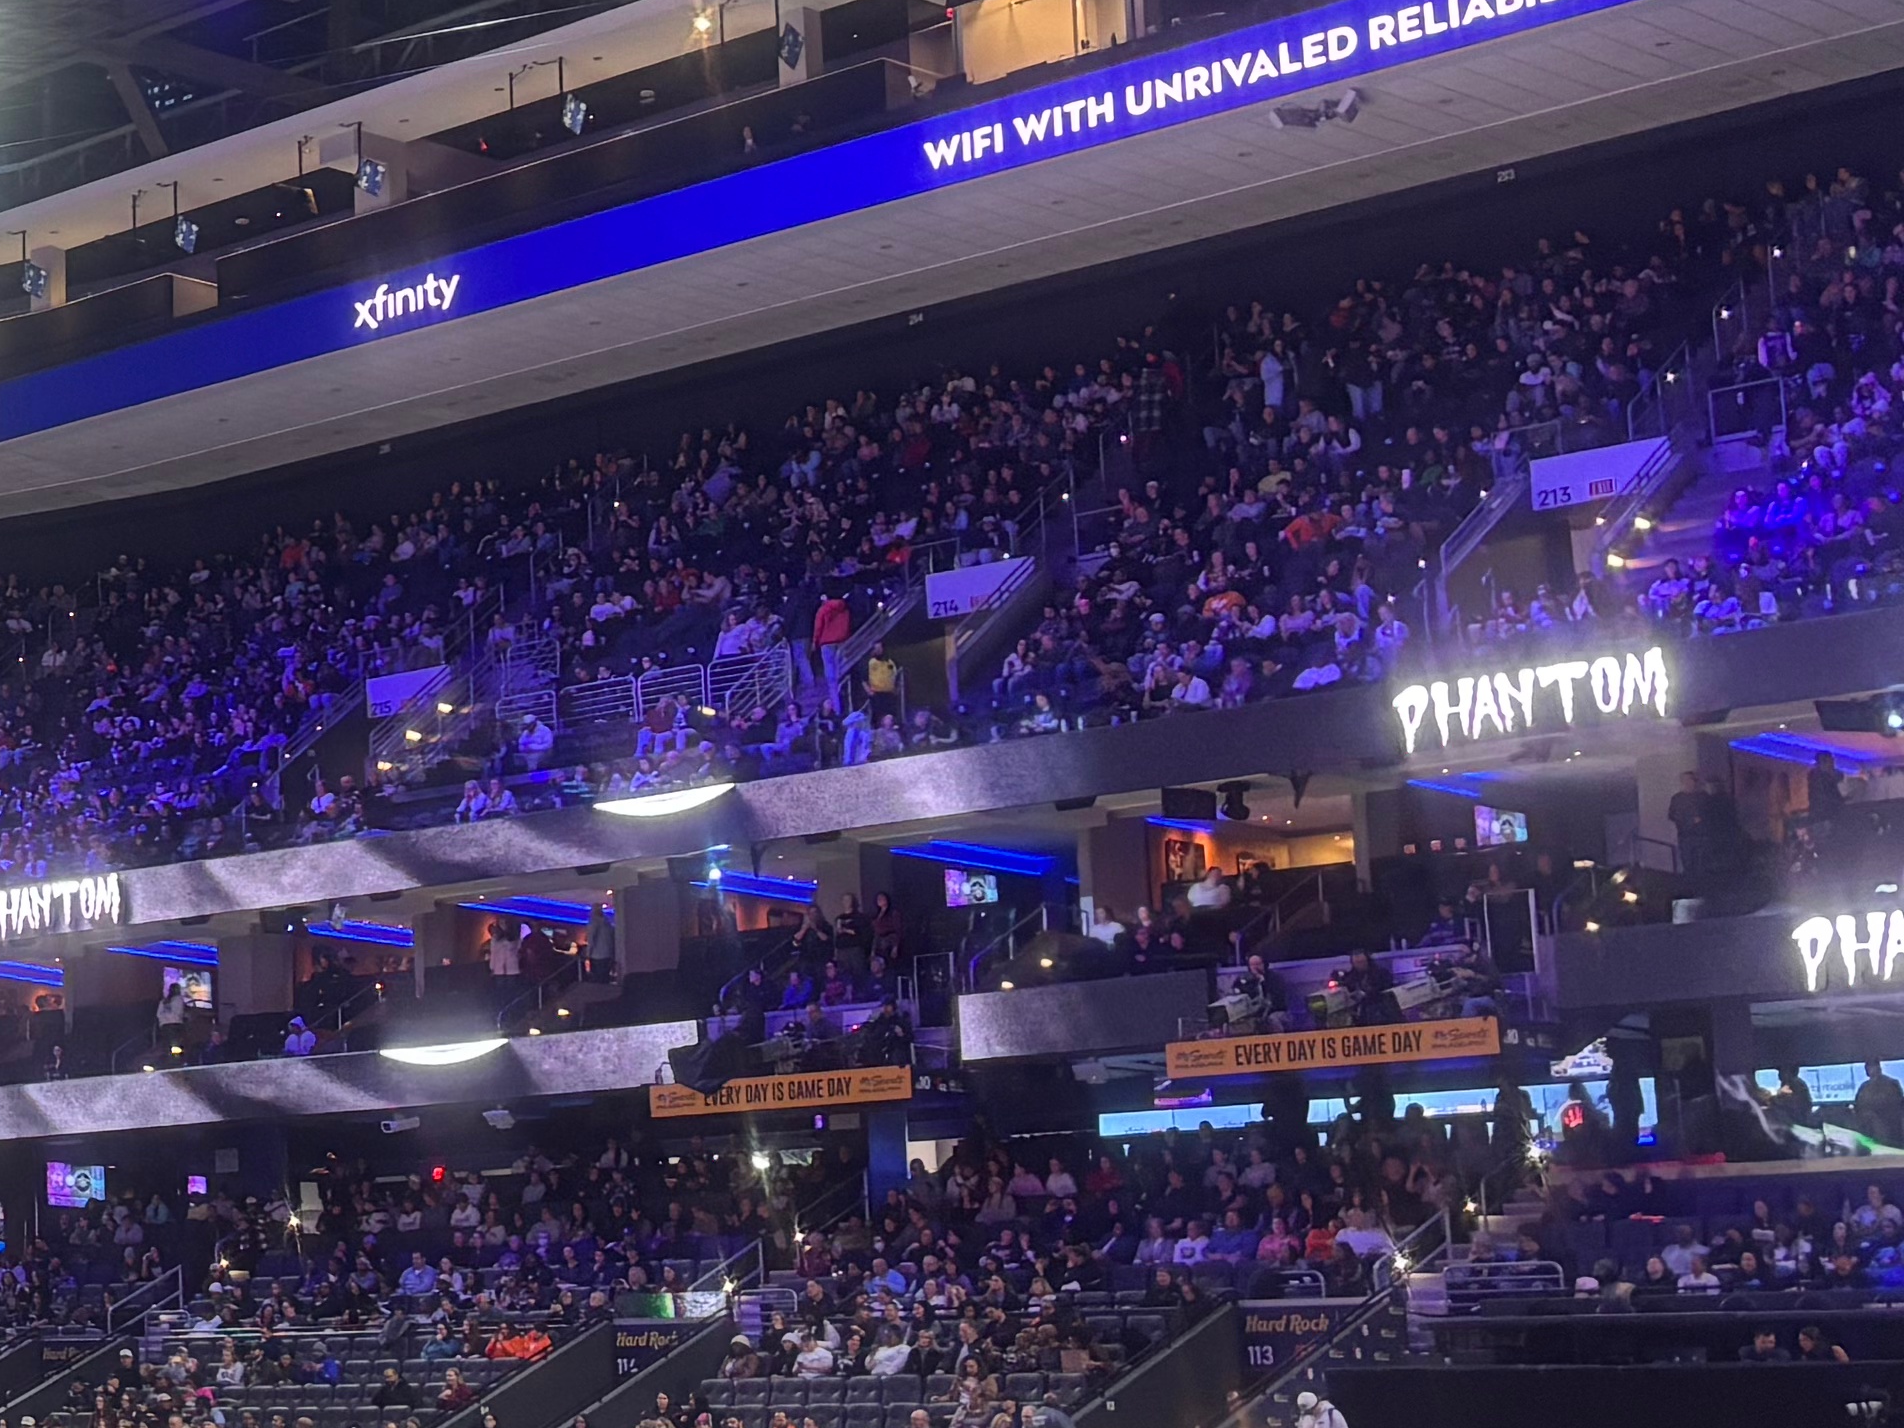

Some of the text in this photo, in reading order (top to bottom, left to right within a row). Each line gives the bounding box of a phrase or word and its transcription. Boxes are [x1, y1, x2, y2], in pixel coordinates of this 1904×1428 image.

[924, 126, 1008, 171] WIFI
[1016, 91, 1115, 148] WITH
[1125, 25, 1358, 121] UNRIVALED
[352, 272, 460, 332] xfinity
[1538, 485, 1571, 508] 213
[933, 599, 958, 616] 214
[373, 700, 391, 714] 215
[1392, 646, 1669, 754] PHANTOM
[1235, 1042, 1281, 1066] EVERY
[1287, 1040, 1316, 1062] DAY
[1322, 1038, 1335, 1059] IS
[1341, 1034, 1387, 1058] GAME
[1392, 1030, 1423, 1052] DAY
[746, 1083, 770, 1103] DAY
[772, 1083, 783, 1101] IS
[788, 1079, 824, 1101] GAME
[828, 1077, 852, 1097] DAY
[1245, 1315, 1329, 1334] Hard Rock
[616, 1332, 646, 1348] Hard
[1248, 1346, 1273, 1364] 113
